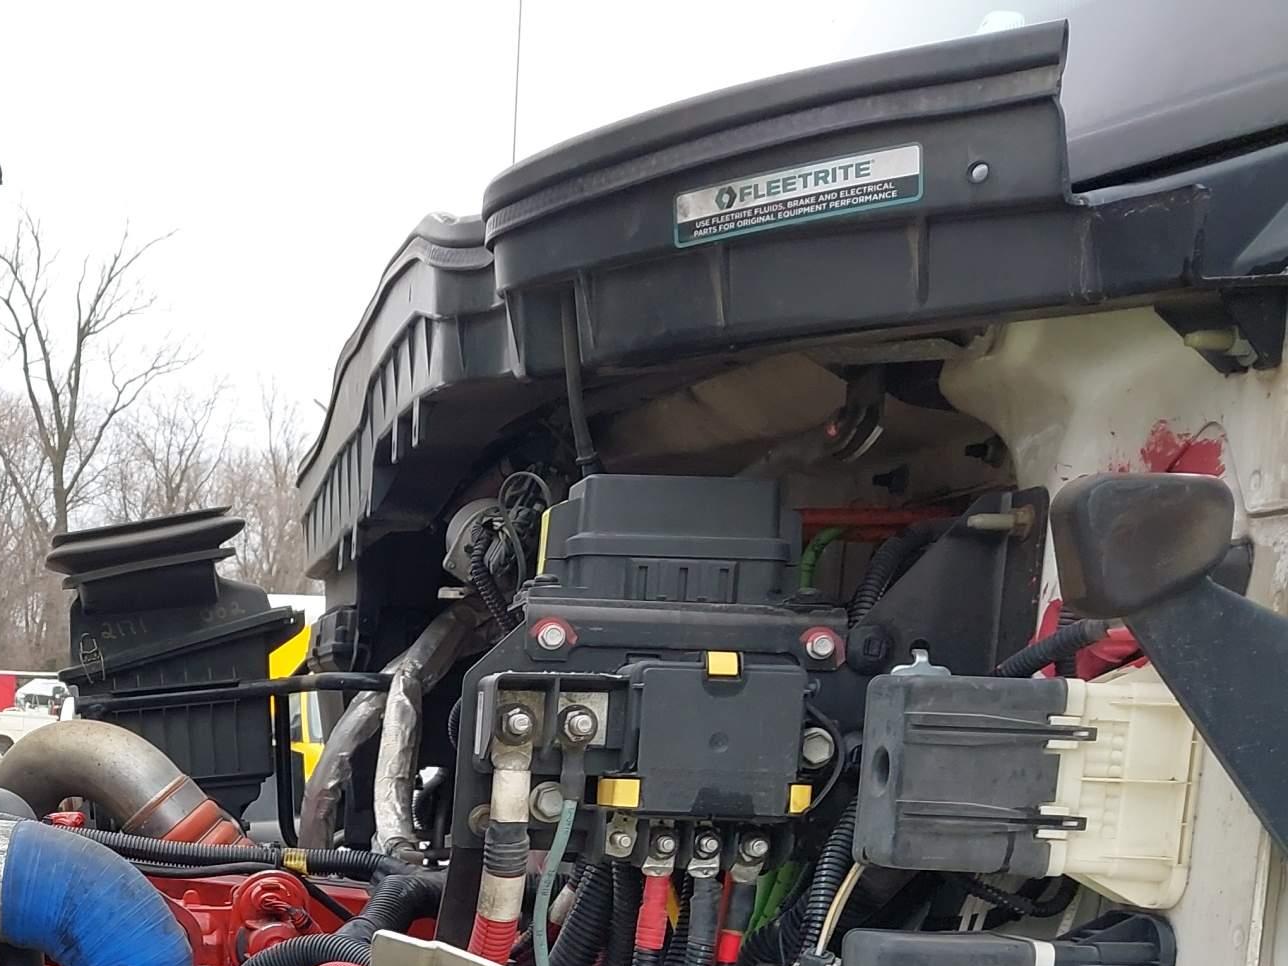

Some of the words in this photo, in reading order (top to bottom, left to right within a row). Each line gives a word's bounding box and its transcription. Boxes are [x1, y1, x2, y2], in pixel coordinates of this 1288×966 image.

[740, 161, 871, 202] FLEETRITE
[693, 227, 718, 238] PARTS
[718, 223, 736, 232] FOR
[736, 213, 777, 228] ORIGINAL
[777, 202, 828, 219] EQUIPMENT
[829, 190, 898, 209] PERFORMANCE
[695, 219, 710, 229] USE
[711, 209, 753, 225] FLEETRITE
[753, 203, 786, 216] FLUIDS,
[786, 196, 817, 208] BRAKE
[818, 191, 838, 203] AND
[839, 182, 896, 198] ELECTRICAL
